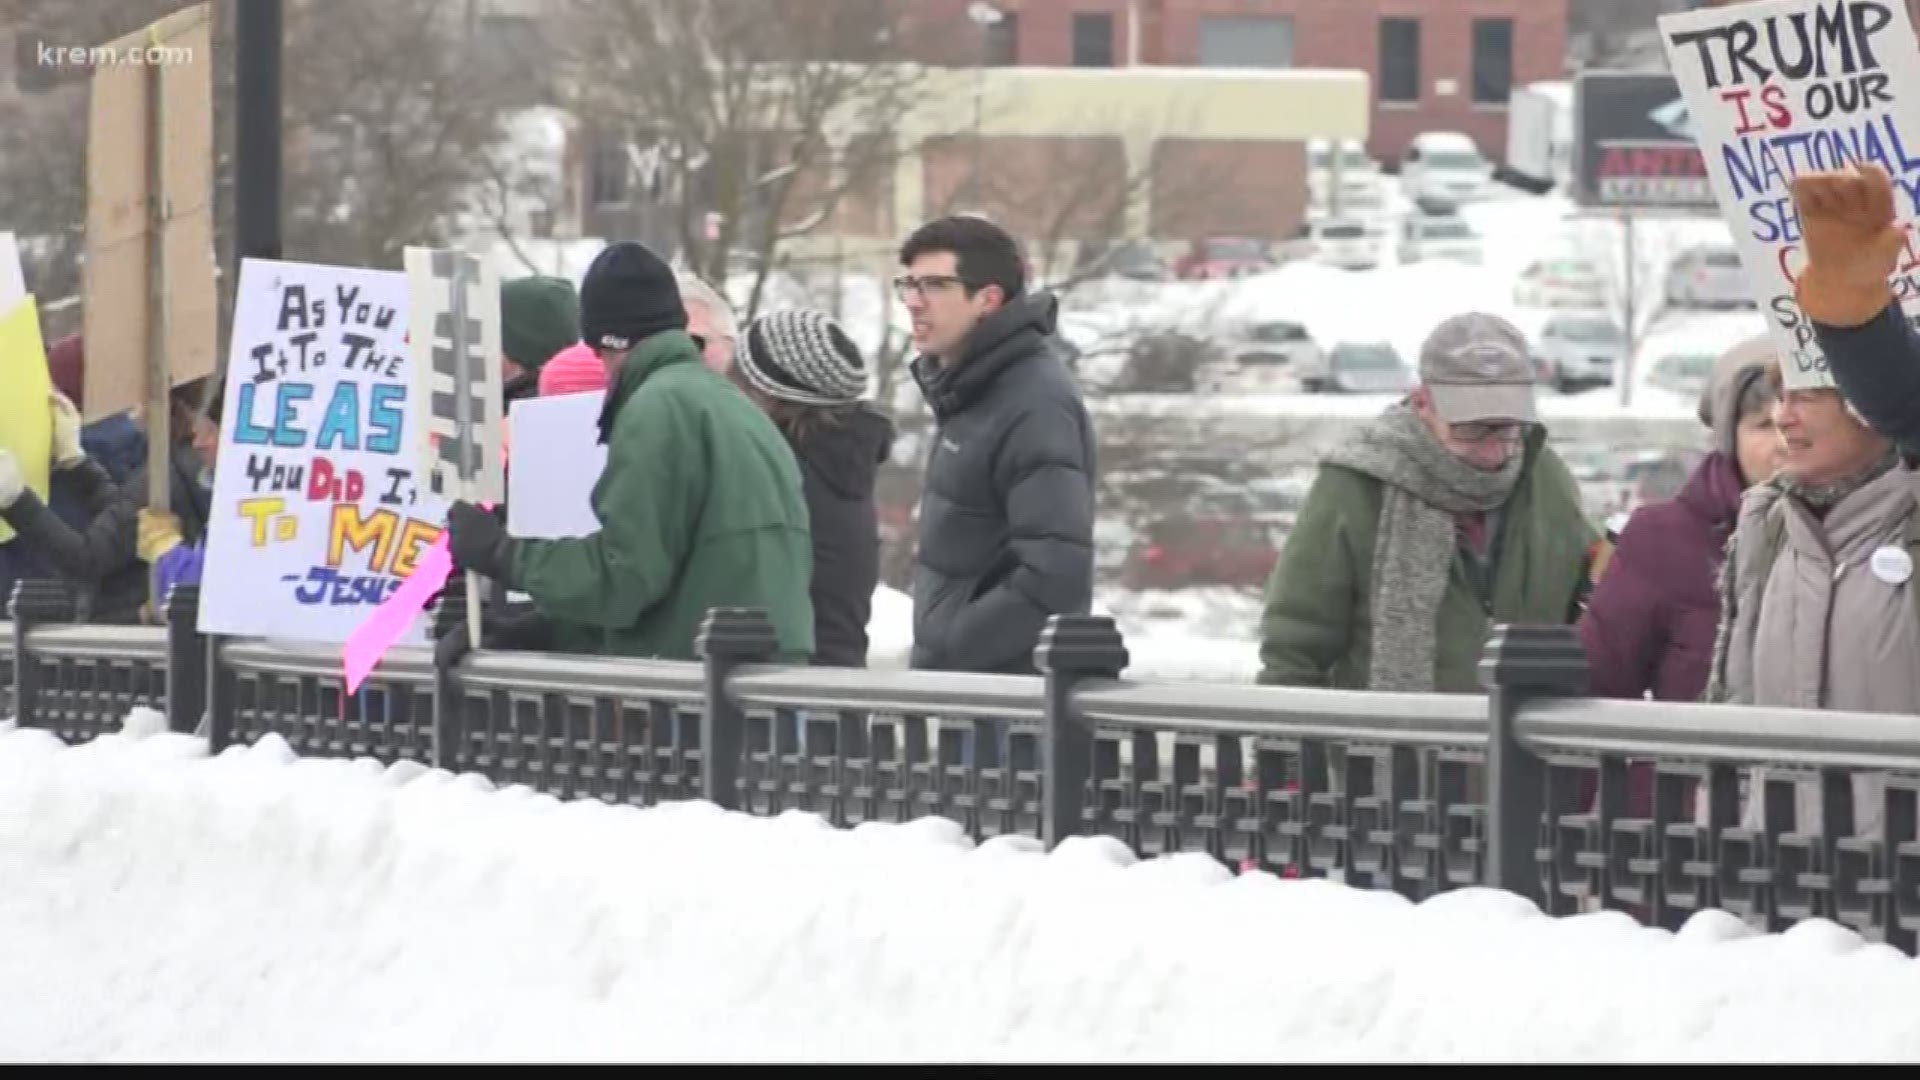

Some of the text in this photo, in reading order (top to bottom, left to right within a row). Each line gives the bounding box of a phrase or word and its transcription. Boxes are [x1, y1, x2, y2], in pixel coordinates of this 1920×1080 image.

[1670, 0, 1893, 89] TRUMP
[1721, 73, 1895, 136] IS OUR
[326, 503, 442, 577] ME
